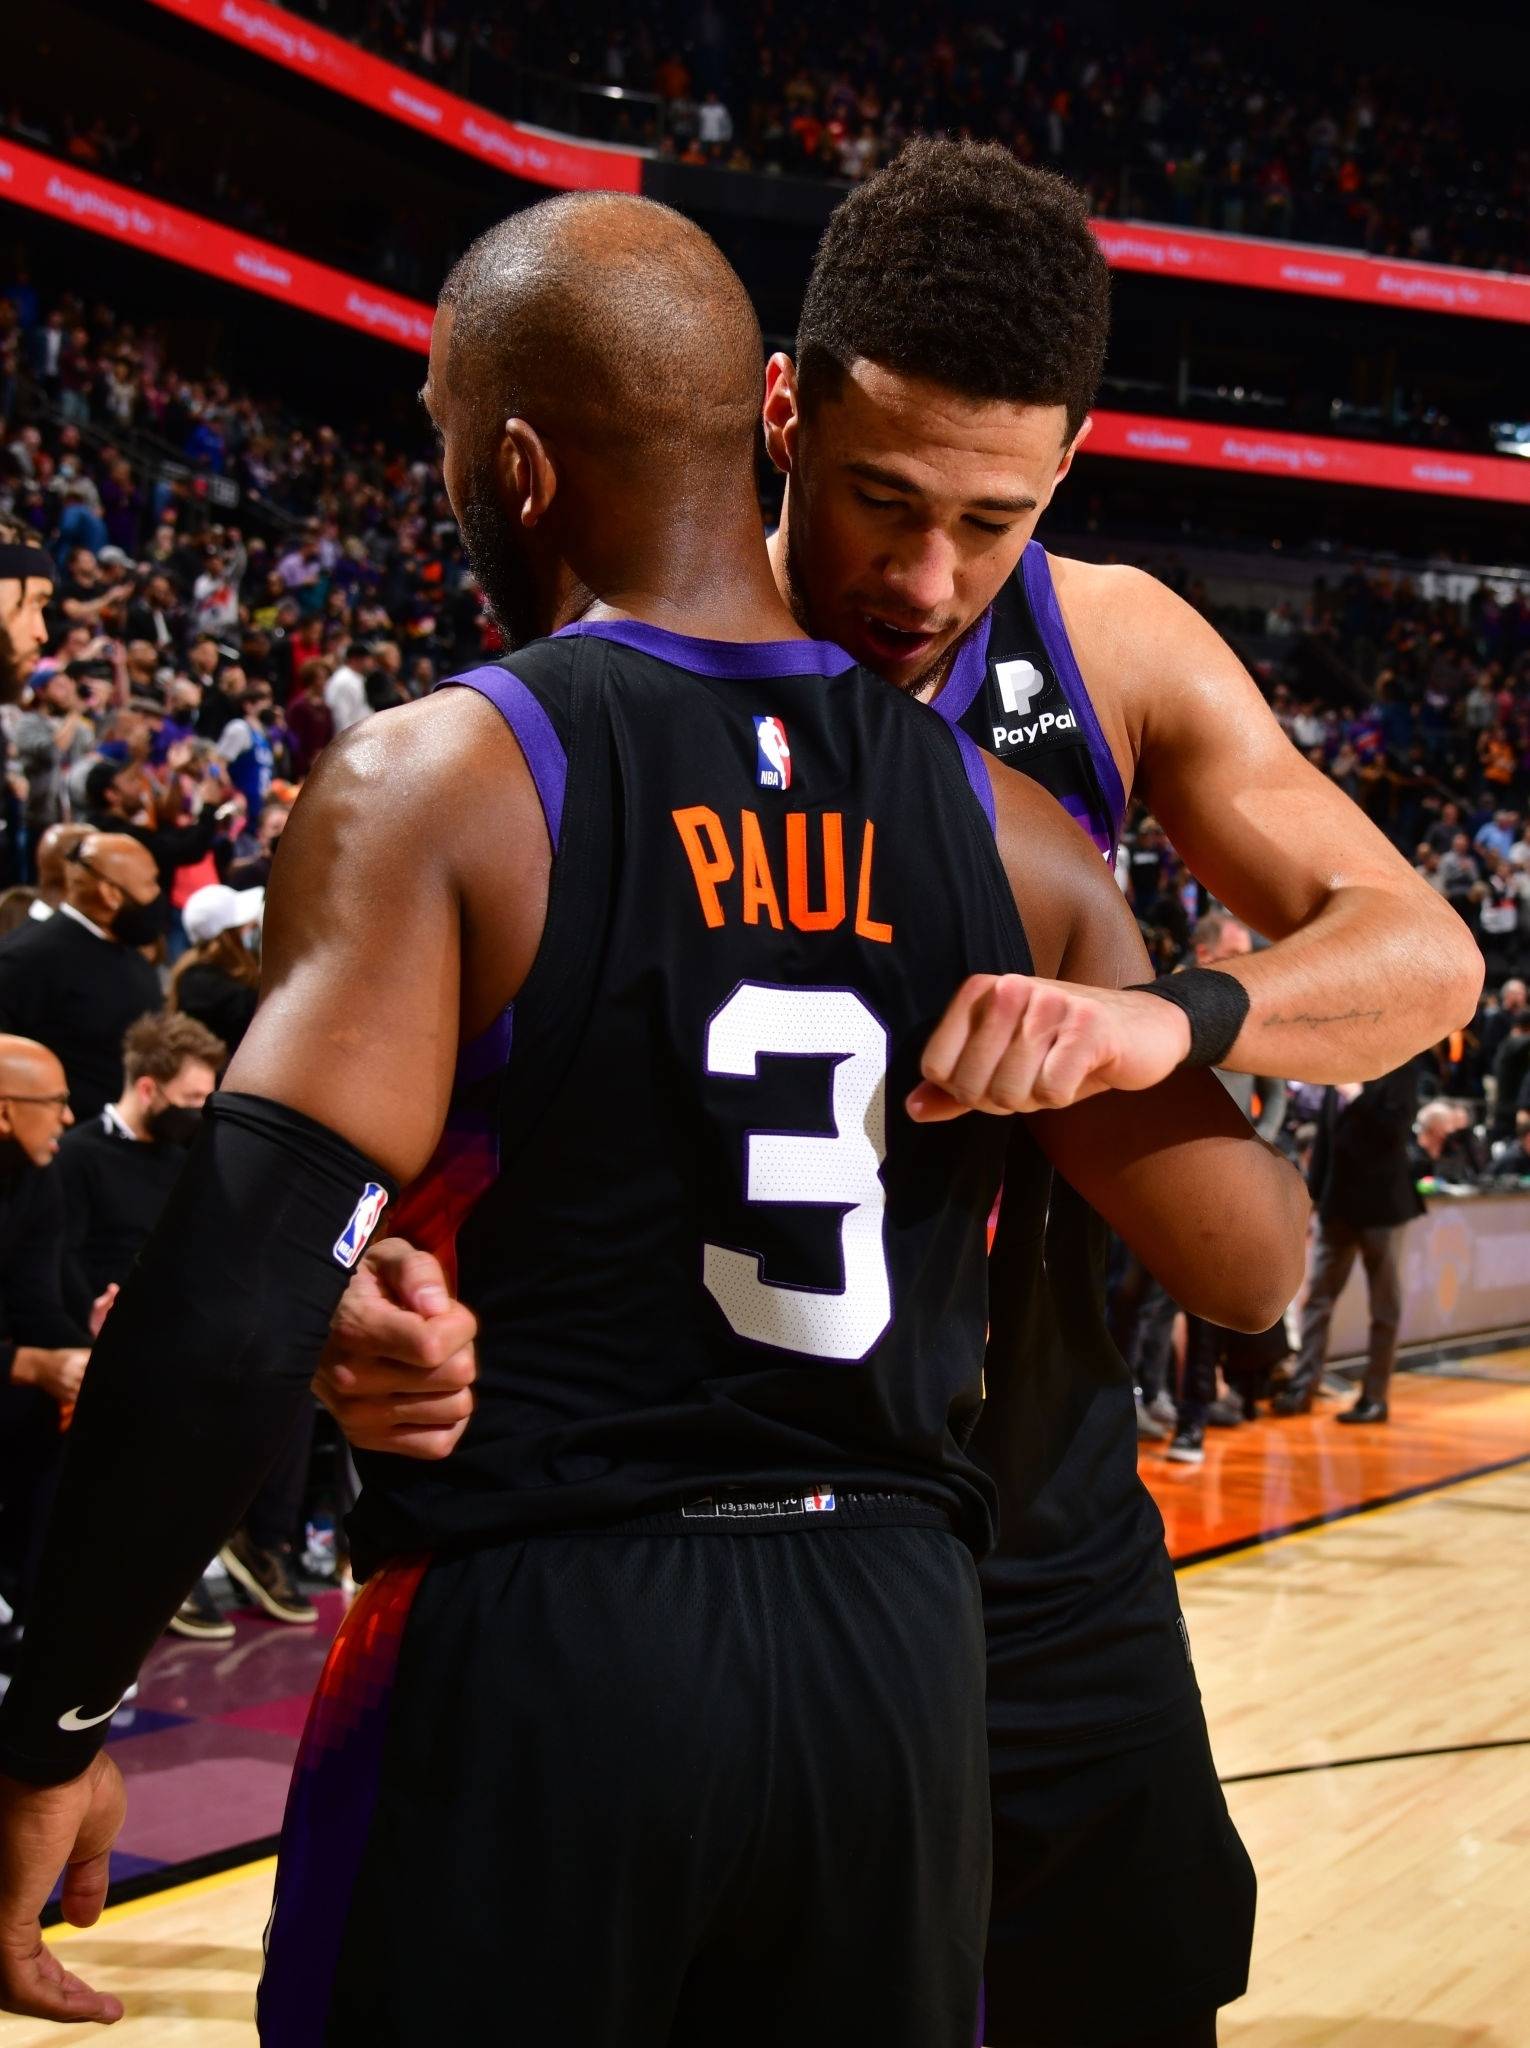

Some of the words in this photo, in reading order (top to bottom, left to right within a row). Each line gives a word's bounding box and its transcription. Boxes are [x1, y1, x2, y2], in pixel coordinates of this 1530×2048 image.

[992, 707, 1077, 749] PayPal
[760, 770, 779, 786] NBA
[671, 805, 893, 944] PAUL
[704, 979, 897, 1366] 3
[337, 1240, 355, 1259] NBA
